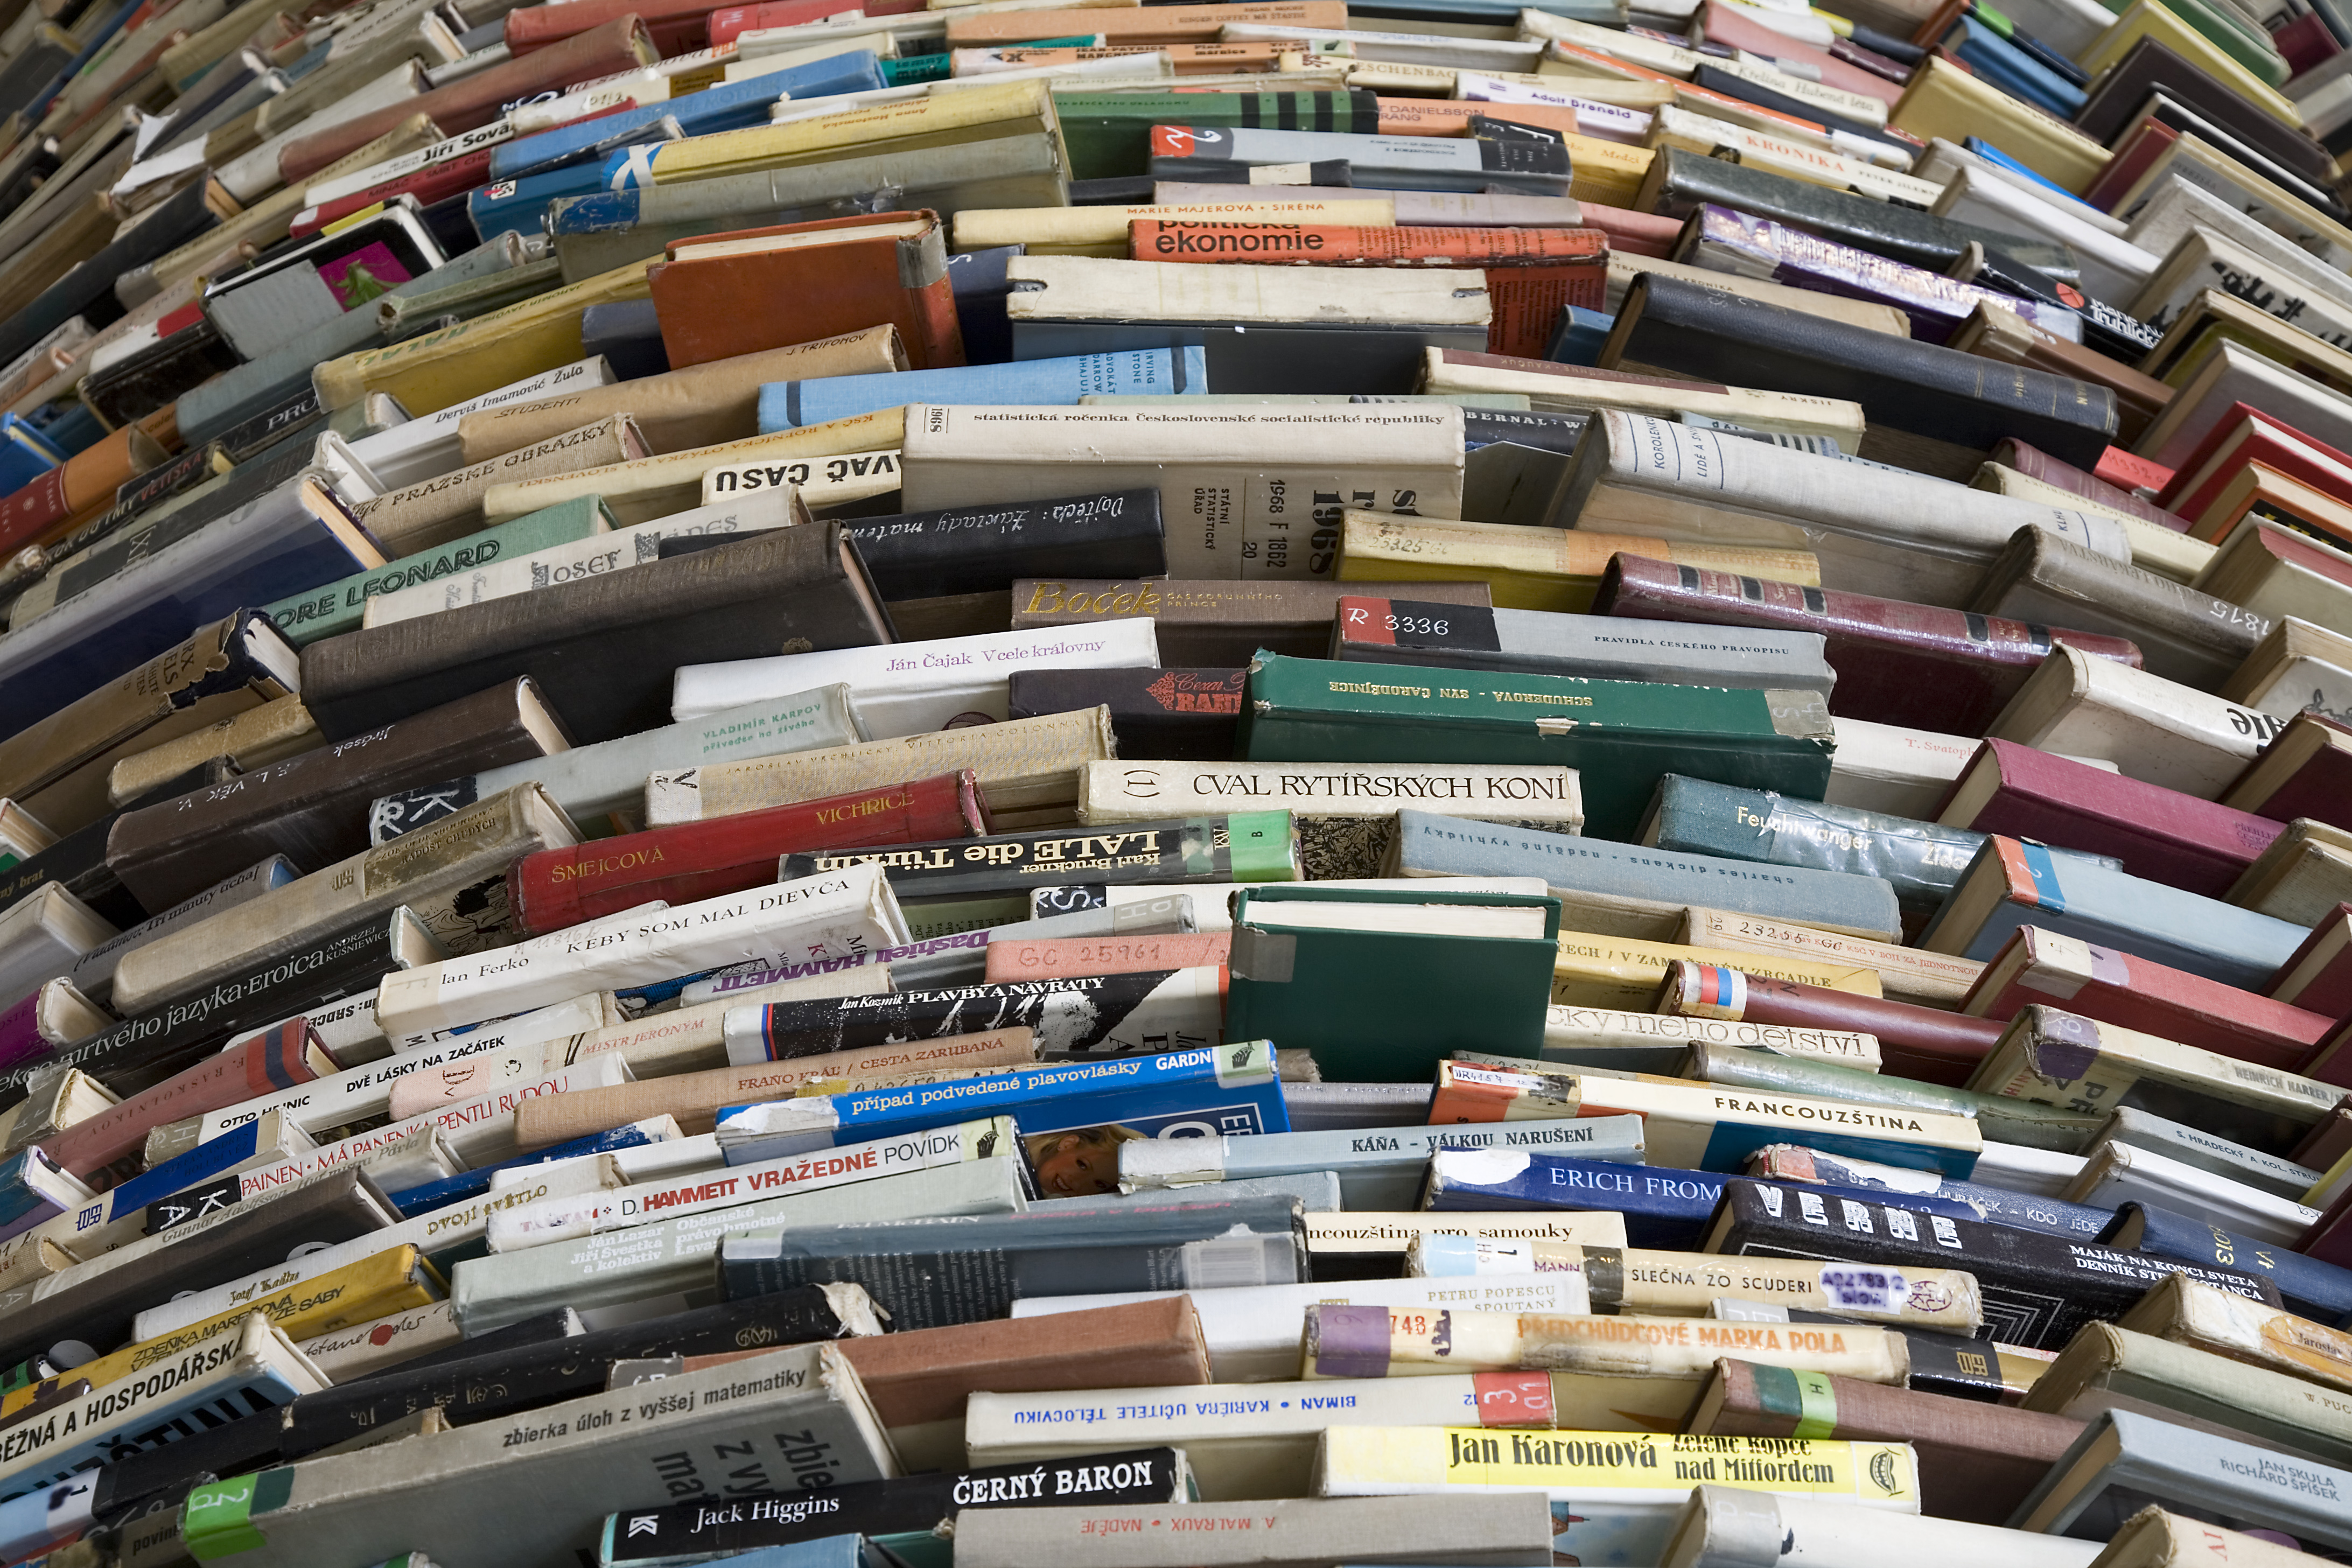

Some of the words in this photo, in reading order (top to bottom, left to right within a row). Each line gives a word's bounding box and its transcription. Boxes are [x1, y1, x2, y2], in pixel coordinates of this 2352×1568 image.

[423, 141, 453, 162] Jiří
[1746, 134, 1846, 173] KRONIKA
[1126, 206, 1173, 215] MARIE
[1178, 202, 1255, 213] MAJEROVÁ
[1272, 201, 1325, 211] SIRÉNA
[1156, 230, 1324, 254] ekonomie
[1684, 276, 1735, 292] KRONIKA
[494, 396, 582, 418] STUDENTI
[800, 333, 869, 355] TRIFONOV
[1132, 353, 1142, 384] STONE
[435, 400, 477, 424] Derviš
[481, 377, 547, 407] Imamović
[552, 363, 584, 385] Žula
[929, 407, 943, 433] 1968
[974, 412, 1059, 422] statistická
[1064, 412, 1130, 423] ročenka
[1136, 410, 1257, 423] Československé
[1261, 412, 1361, 424] socialistické
[1364, 413, 1444, 427] republiky
[1466, 411, 1546, 427] BERNAL
[715, 463, 810, 493] ČASU
[1194, 488, 1203, 514] ÚŘAD
[1221, 488, 1230, 524] STÁTNÍ
[1269, 479, 1286, 514] 1968
[1205, 488, 1217, 550] STATISTICKÝ
[1267, 535, 1287, 569] 1862
[346, 535, 485, 607] LEONARD
[1022, 581, 1162, 615] Boček
[1384, 614, 1450, 636] 3336
[886, 657, 916, 673] Ján
[923, 650, 973, 668] Čajak
[1032, 640, 1106, 659] královny
[1594, 635, 1655, 647] PRAVIDLA
[1660, 640, 1718, 651] ČESKÉHO
[1721, 645, 1789, 655] PRAVOPISU
[1440, 689, 1469, 698] SYN
[1492, 691, 1593, 707] SCHUDEROVÁ
[772, 703, 822, 723] KARPOV
[1194, 774, 1271, 795] CVAL
[1282, 771, 1473, 799] RYTÍŘSKÝCH
[1487, 774, 1567, 800] KONÍ
[964, 844, 1023, 864] die
[1034, 830, 1160, 860] LALE
[551, 845, 665, 884] ŠMEJCOVÁ
[1019, 857, 1110, 874] Bruckner
[1125, 853, 1161, 866] Karl
[1632, 857, 1706, 872] dickens
[1719, 868, 1794, 884] charles
[326, 925, 376, 952] ANDRZEJ
[479, 956, 530, 978] Ferko
[567, 928, 631, 954] KEBY
[639, 918, 689, 937] SOM
[700, 906, 750, 926] MAL
[758, 879, 851, 910] DIEVČA
[62, 1016, 163, 1069] mrtvého
[163, 981, 242, 1035] jazyka
[247, 949, 328, 993] Eroica
[838, 996, 859, 1010] Jan
[992, 988, 1003, 996] A
[346, 1073, 370, 1093] DVĚ
[376, 1061, 418, 1084] LÁSKY
[423, 1051, 443, 1069] NA
[448, 1034, 506, 1063] ZAČÁTEK
[737, 1073, 795, 1091] FRAŇO
[860, 1054, 912, 1070] CESTA
[915, 1038, 1005, 1061] ZARUBANÁ
[851, 1091, 914, 1116] případ
[920, 1078, 1020, 1106] podvedené
[1027, 1062, 1142, 1089] plavovlásky
[1156, 1051, 1213, 1071] GARDN
[220, 1111, 256, 1129] OTTO
[1715, 1096, 1925, 1133] FRANCOUZŠTINA
[241, 1161, 303, 1196] PAINEN
[317, 1144, 347, 1168] MÁ
[437, 1098, 493, 1128] PENTLI
[1426, 1133, 1494, 1149] VÁLKOU
[1505, 1127, 1594, 1145] NARUŠENÍ
[2189, 1132, 2245, 1158] HRADECKÝ
[643, 1178, 740, 1214] HAMMETT
[746, 1148, 879, 1192] VRAŽEDNÉ
[1550, 1168, 1634, 1193] ERICH
[1437, 1227, 1468, 1238] pro
[1478, 1223, 1573, 1241] samouky
[2070, 1244, 2124, 1263] MAJÁK
[2129, 1256, 2151, 1266] NA
[2154, 1258, 2203, 1277] KONCI
[2207, 1273, 2257, 1289] SVETA
[2075, 1257, 2136, 1277] DENNÍK
[1428, 1287, 1478, 1301] PETRU
[1485, 1285, 1556, 1299] POPESCU
[1631, 1269, 1696, 1286] SLEČNA
[1707, 1271, 1731, 1286] ZO
[1742, 1277, 1812, 1293] SCUDERI
[1699, 1328, 1781, 1350] MARKA
[1789, 1331, 1847, 1353] POLA
[503, 1423, 568, 1447] zbierka
[576, 1409, 613, 1432] úloh
[640, 1390, 696, 1419] vyššej
[703, 1367, 807, 1405] matematiky
[1117, 1402, 1187, 1418] UČITELE
[1197, 1399, 1270, 1416] KARIÉRA
[1301, 1395, 1357, 1410] BIMAN
[1013, 1410, 1107, 1424] TĚLOCVIKU
[1449, 1432, 1500, 1468] Jan
[1512, 1434, 1657, 1469] Karonová
[952, 1466, 1047, 1506] ČERNÝ
[1055, 1460, 1154, 1495] BARON
[1675, 1460, 1717, 1481] nad
[2220, 1458, 2288, 1486] RICHARD
[2259, 1458, 2285, 1474] JAN
[2288, 1467, 2336, 1486] SKULA
[691, 1500, 744, 1534] Jack
[751, 1495, 840, 1524] Higgins
[1081, 1518, 1143, 1535] NADĚJE
[1171, 1516, 1251, 1531] MALRAUX
